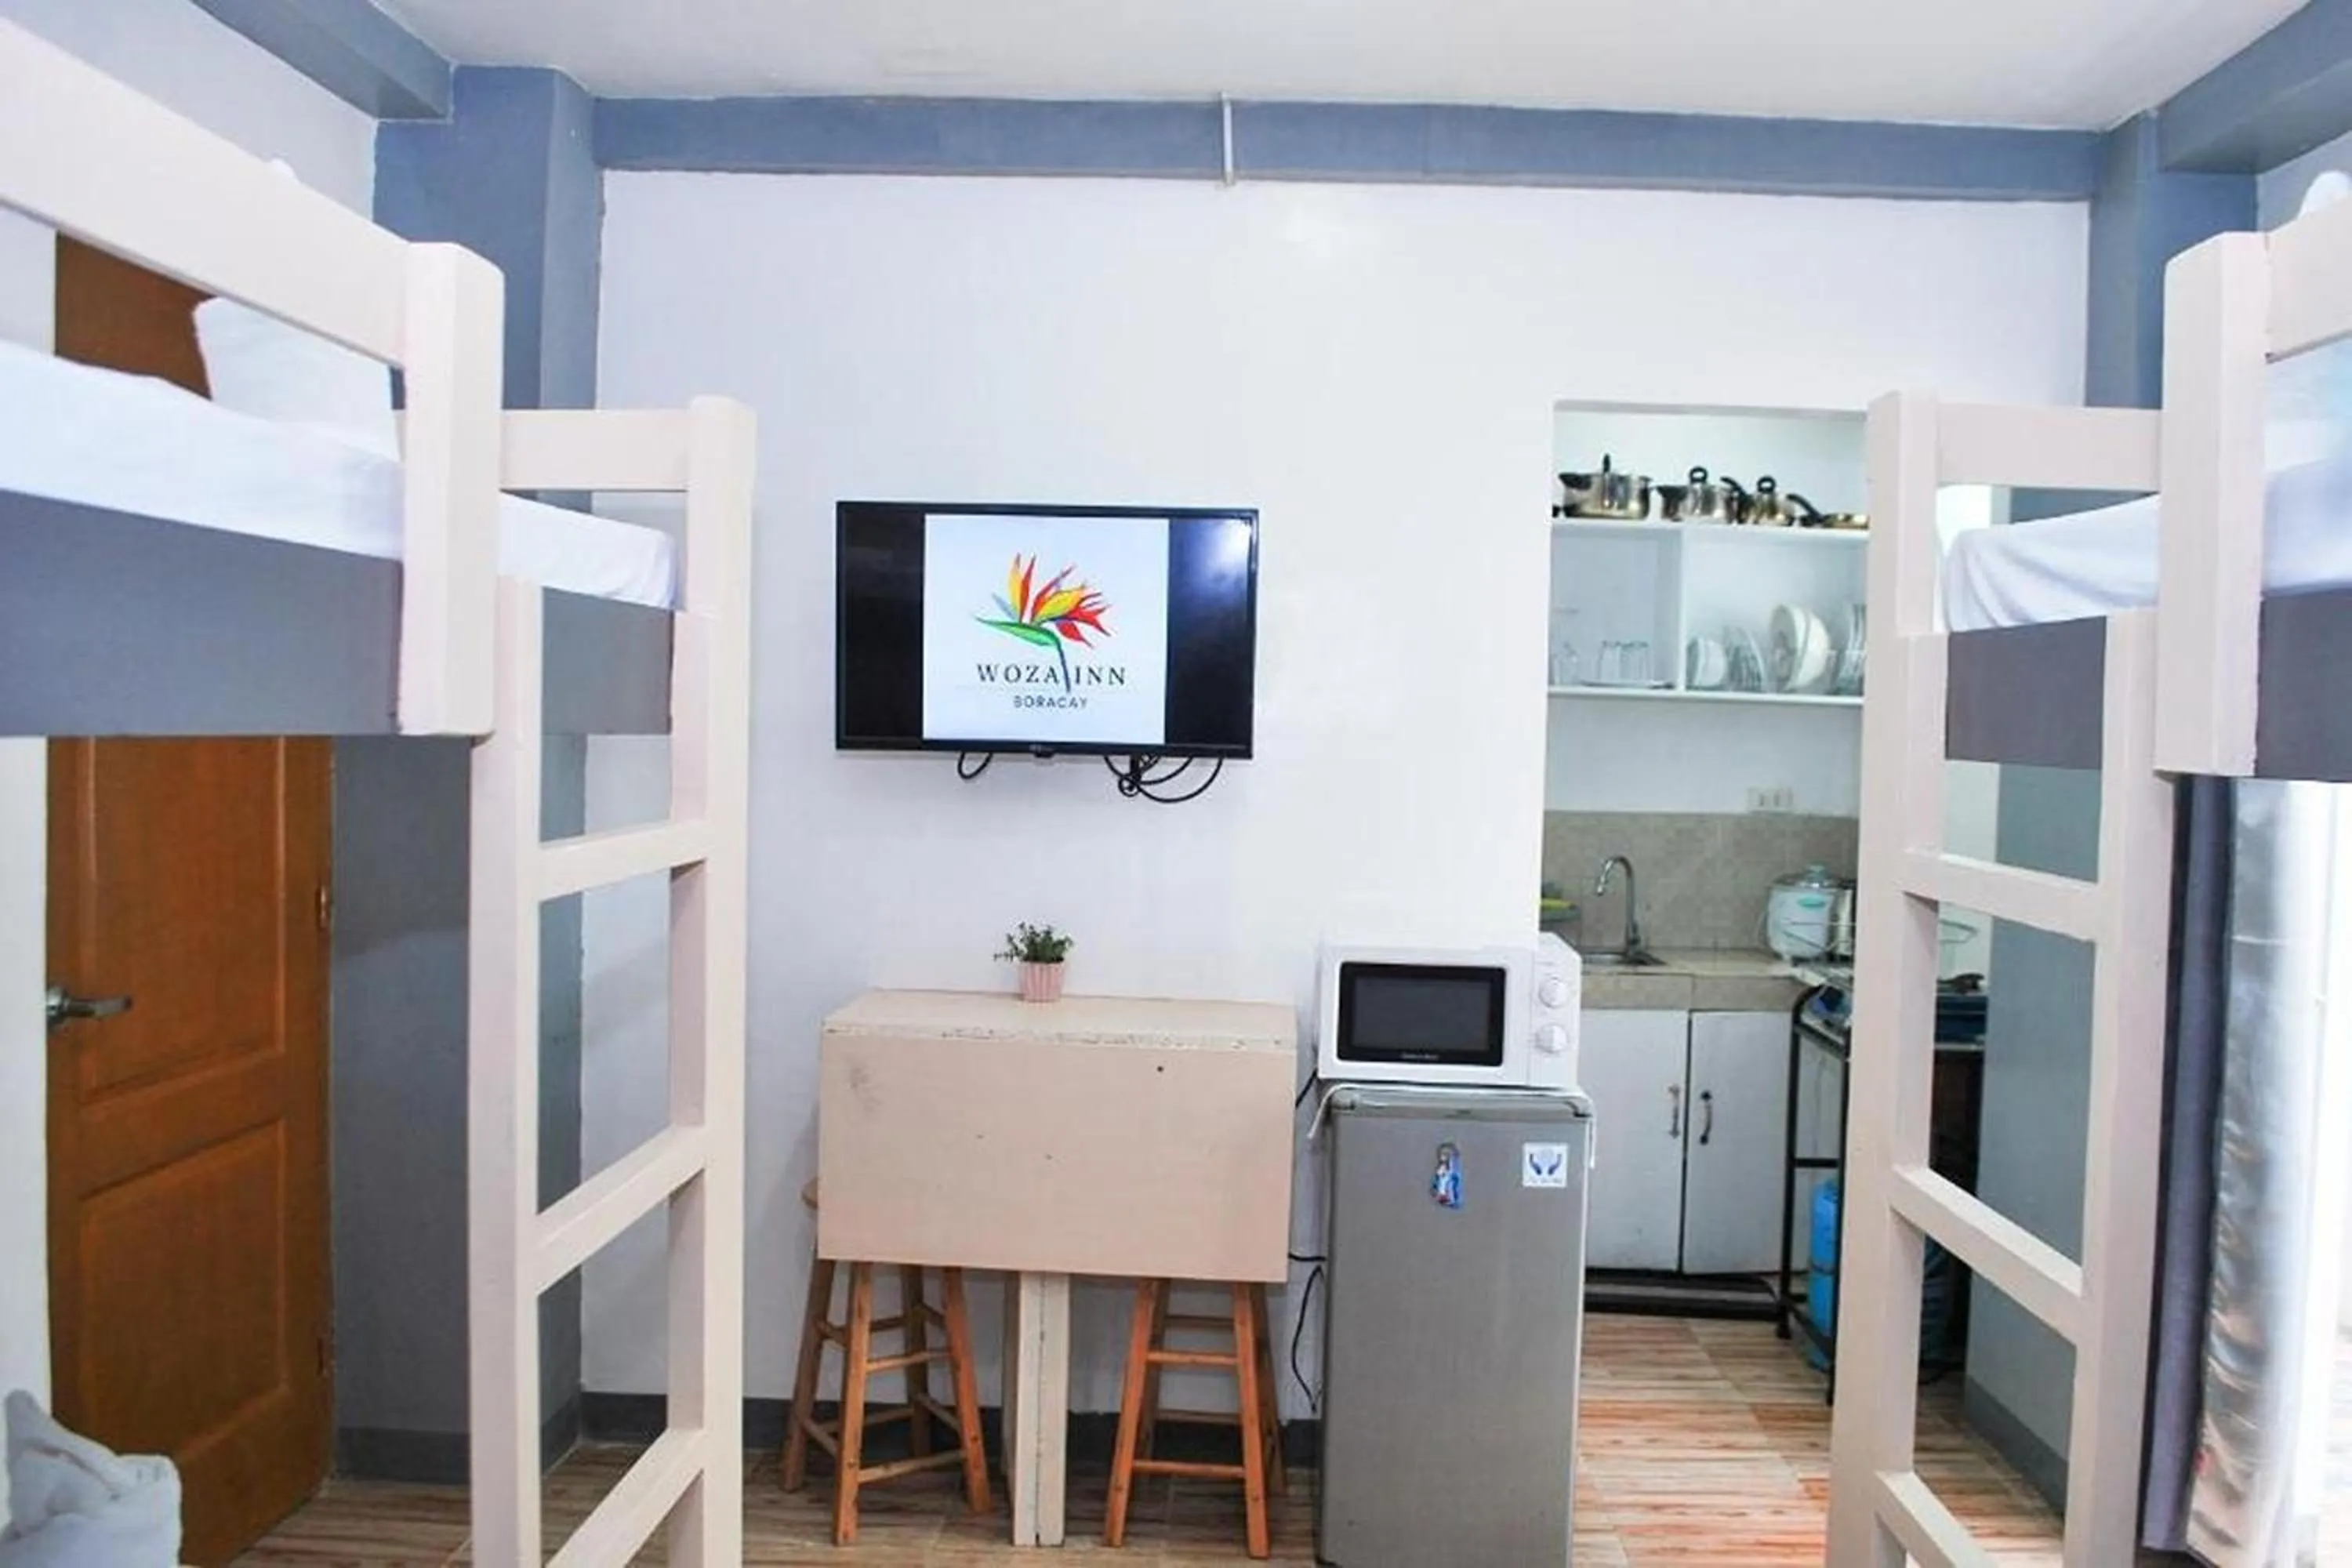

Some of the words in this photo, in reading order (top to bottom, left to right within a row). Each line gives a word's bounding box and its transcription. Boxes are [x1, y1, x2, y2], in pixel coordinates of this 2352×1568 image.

[976, 663, 1060, 684] WOZA
[1075, 666, 1126, 685] INN
[1013, 695, 1087, 709] BORACAY
